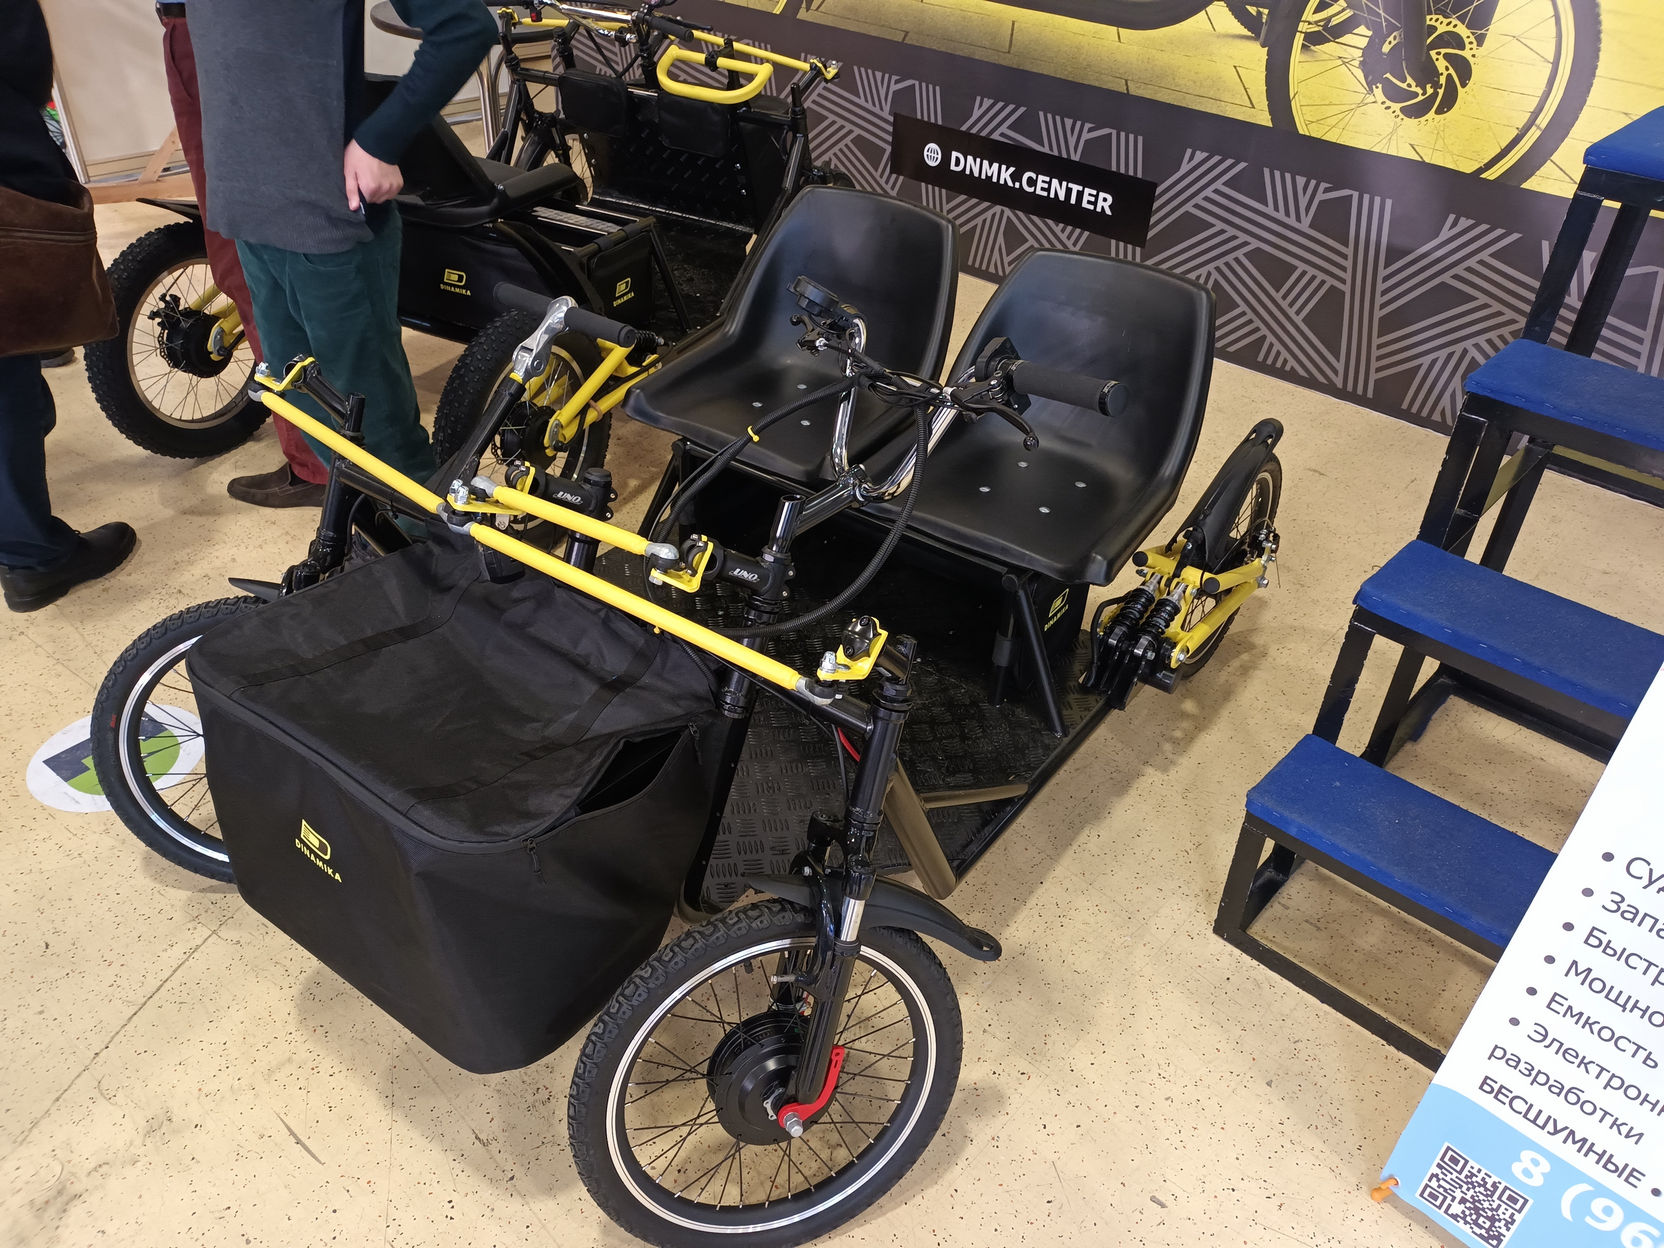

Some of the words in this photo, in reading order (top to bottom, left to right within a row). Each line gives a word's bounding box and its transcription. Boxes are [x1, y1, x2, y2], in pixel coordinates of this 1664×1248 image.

[950, 150, 1113, 216] DNMK.CENTER
[440, 283, 471, 296] DINAMIKA
[556, 491, 582, 503] UNO
[732, 568, 759, 581] UNO
[295, 838, 342, 883] DINAMIKA
[1625, 857, 1664, 895] Су
[1564, 959, 1664, 1028] Мощно
[1546, 992, 1659, 1069] Емкость
[1487, 1044, 1645, 1146] разработки
[1527, 1022, 1664, 1116] Электрон
[1478, 1075, 1646, 1189] БЕСШУМНЫЕ
[1511, 1149, 1551, 1187] 8
[1560, 1183, 1664, 1248] (96
